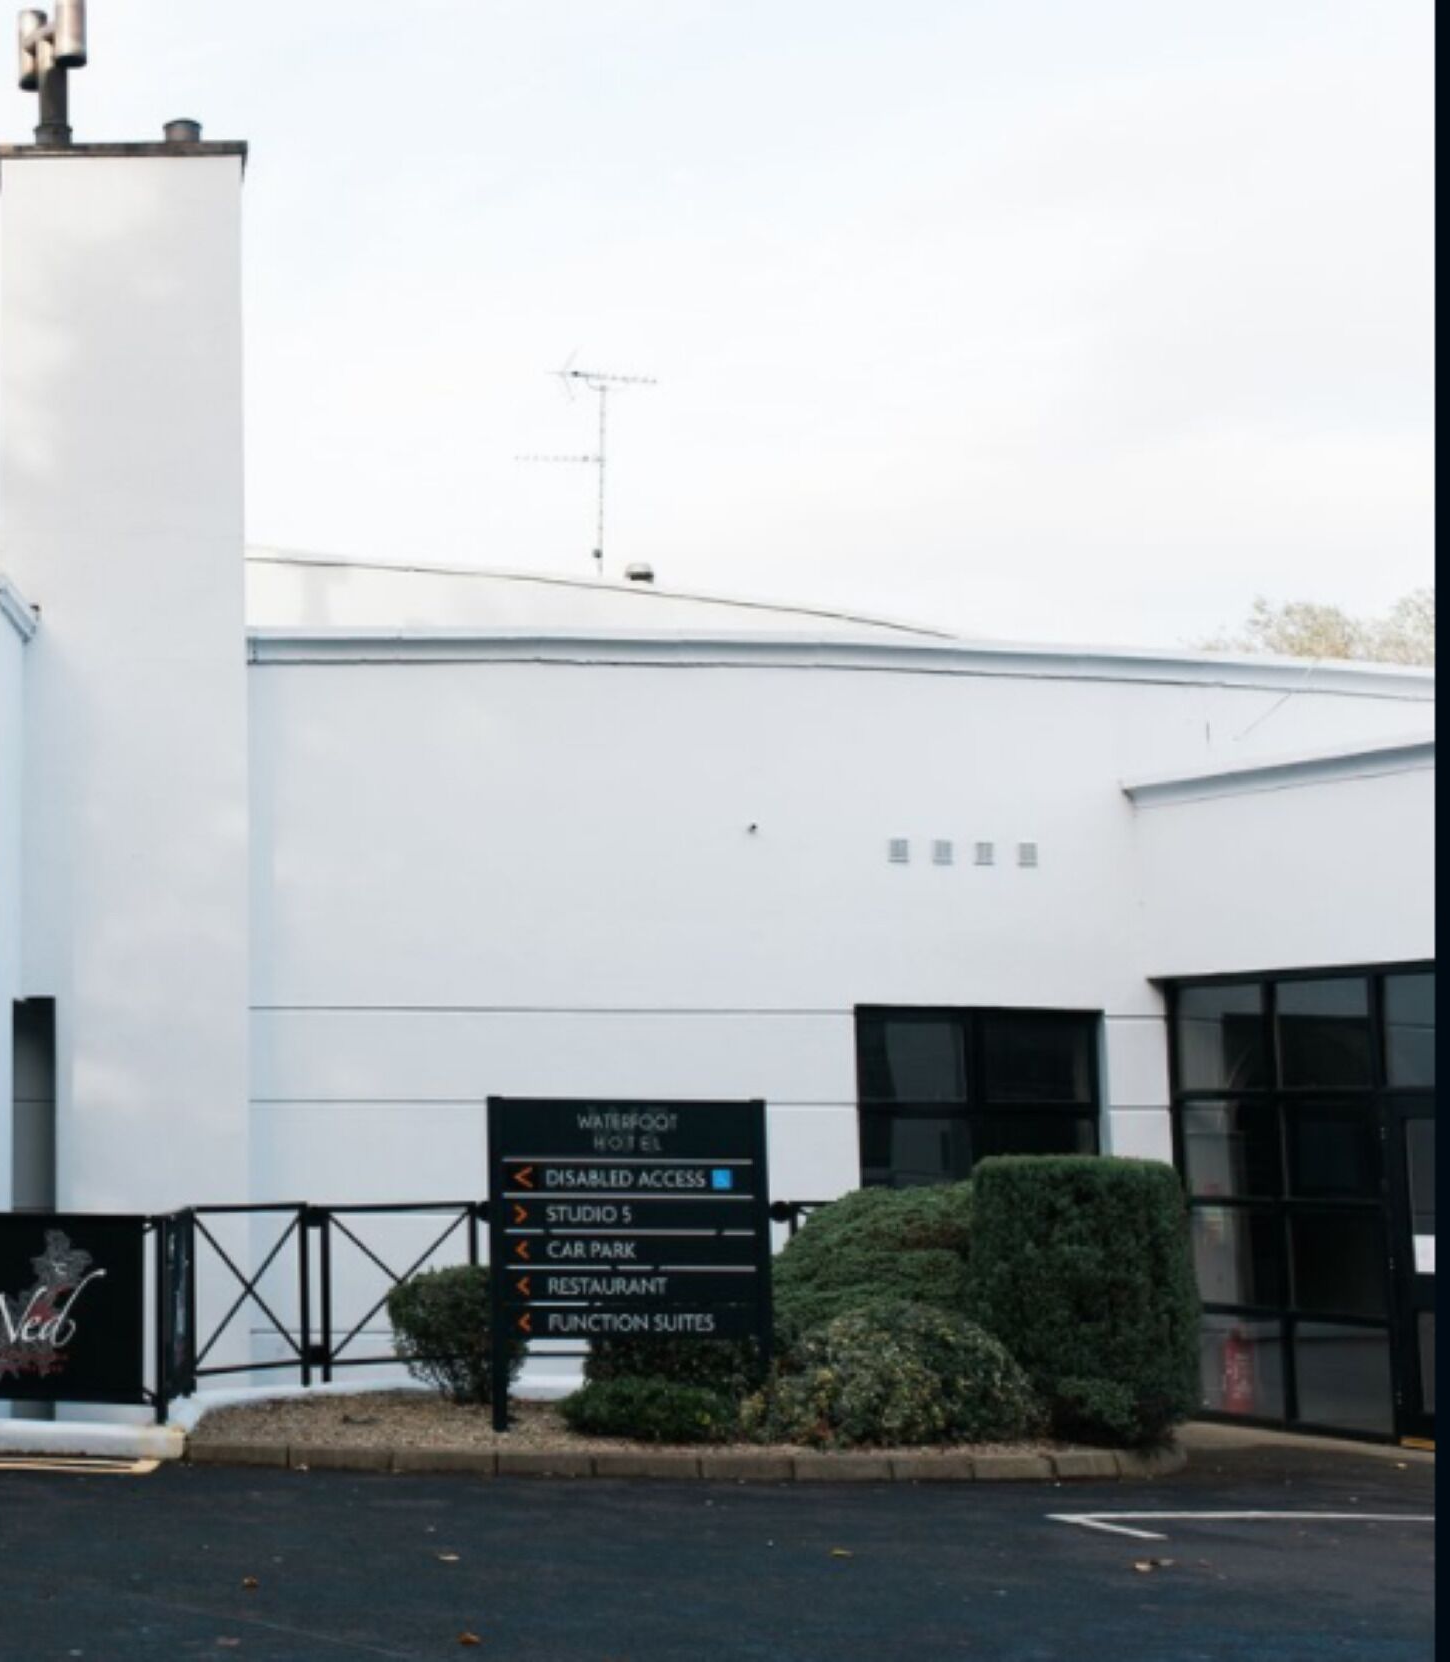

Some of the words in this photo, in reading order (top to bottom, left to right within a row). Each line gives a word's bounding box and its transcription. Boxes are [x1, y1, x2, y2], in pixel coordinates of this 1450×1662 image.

[577, 1113, 678, 1131] WATERFOOT
[594, 1135, 662, 1151] HOTEL
[545, 1170, 633, 1188] DISABLED
[638, 1170, 706, 1188] ACCESS
[546, 1206, 617, 1222] STUDIO
[622, 1206, 632, 1222] 5
[546, 1242, 586, 1259] CAR
[590, 1242, 636, 1259] PARK
[548, 1277, 667, 1295] RESTAURANT
[548, 1313, 649, 1332] FUNCTION
[653, 1313, 715, 1332] SUITES
